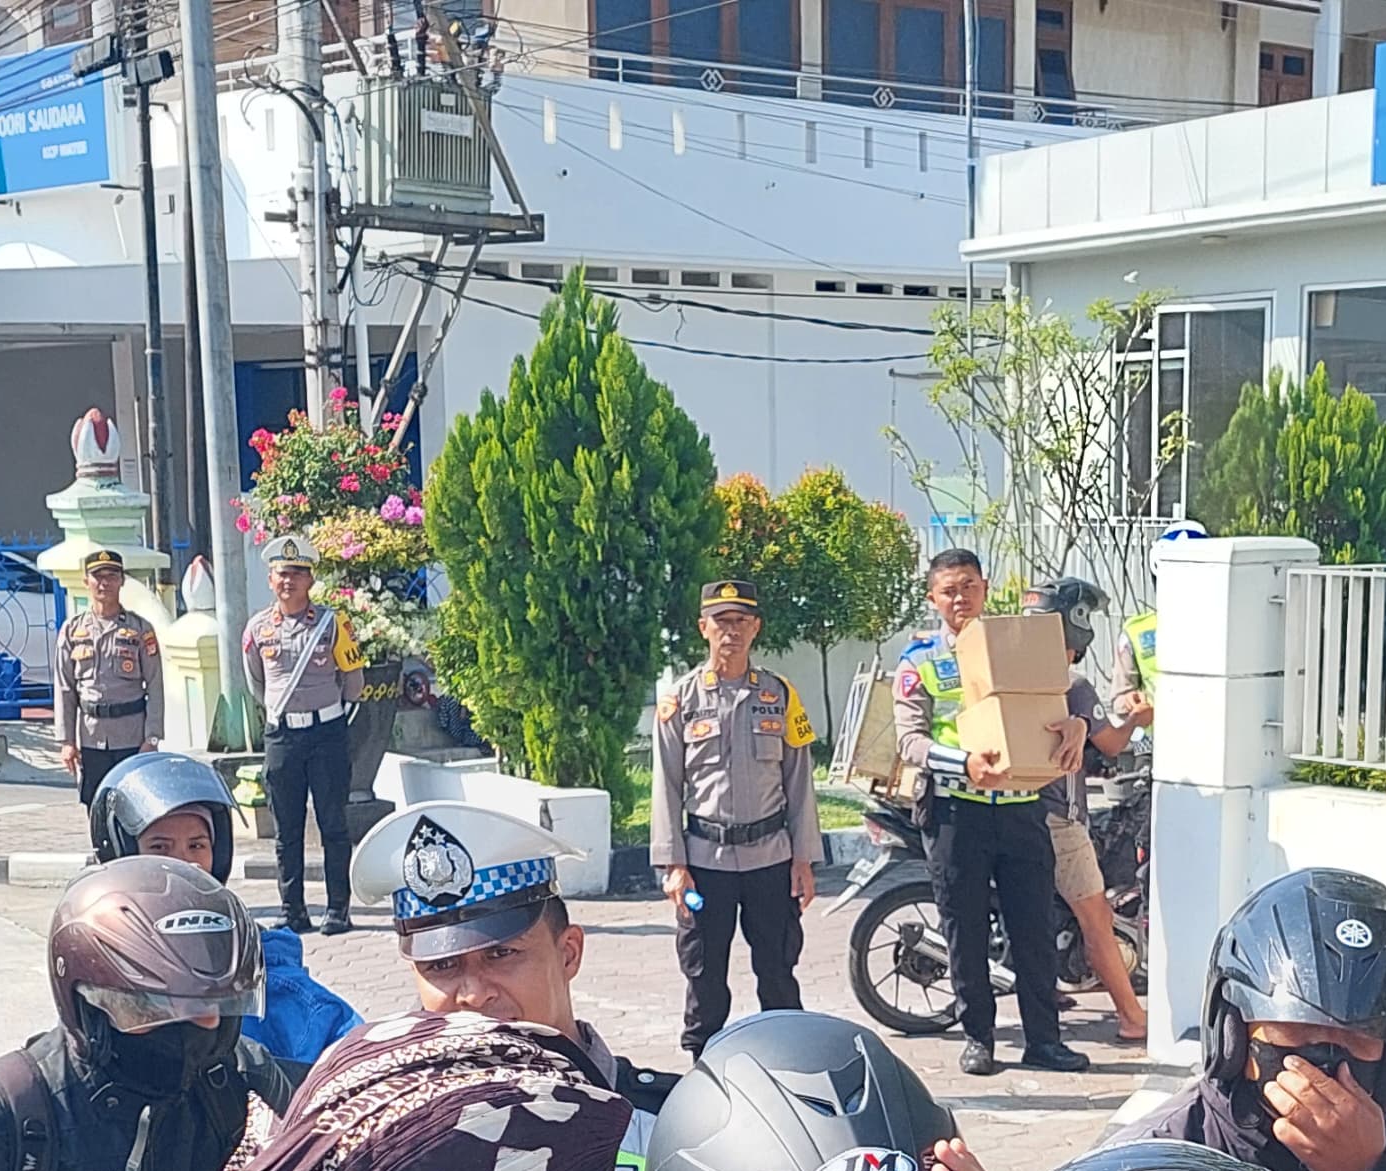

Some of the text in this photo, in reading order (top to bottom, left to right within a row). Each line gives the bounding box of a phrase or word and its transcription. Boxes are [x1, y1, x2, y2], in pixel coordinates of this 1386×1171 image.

[28, 103, 86, 131] SAUDARA
[752, 706, 785, 715] POLRI
[164, 915, 224, 930] INK
